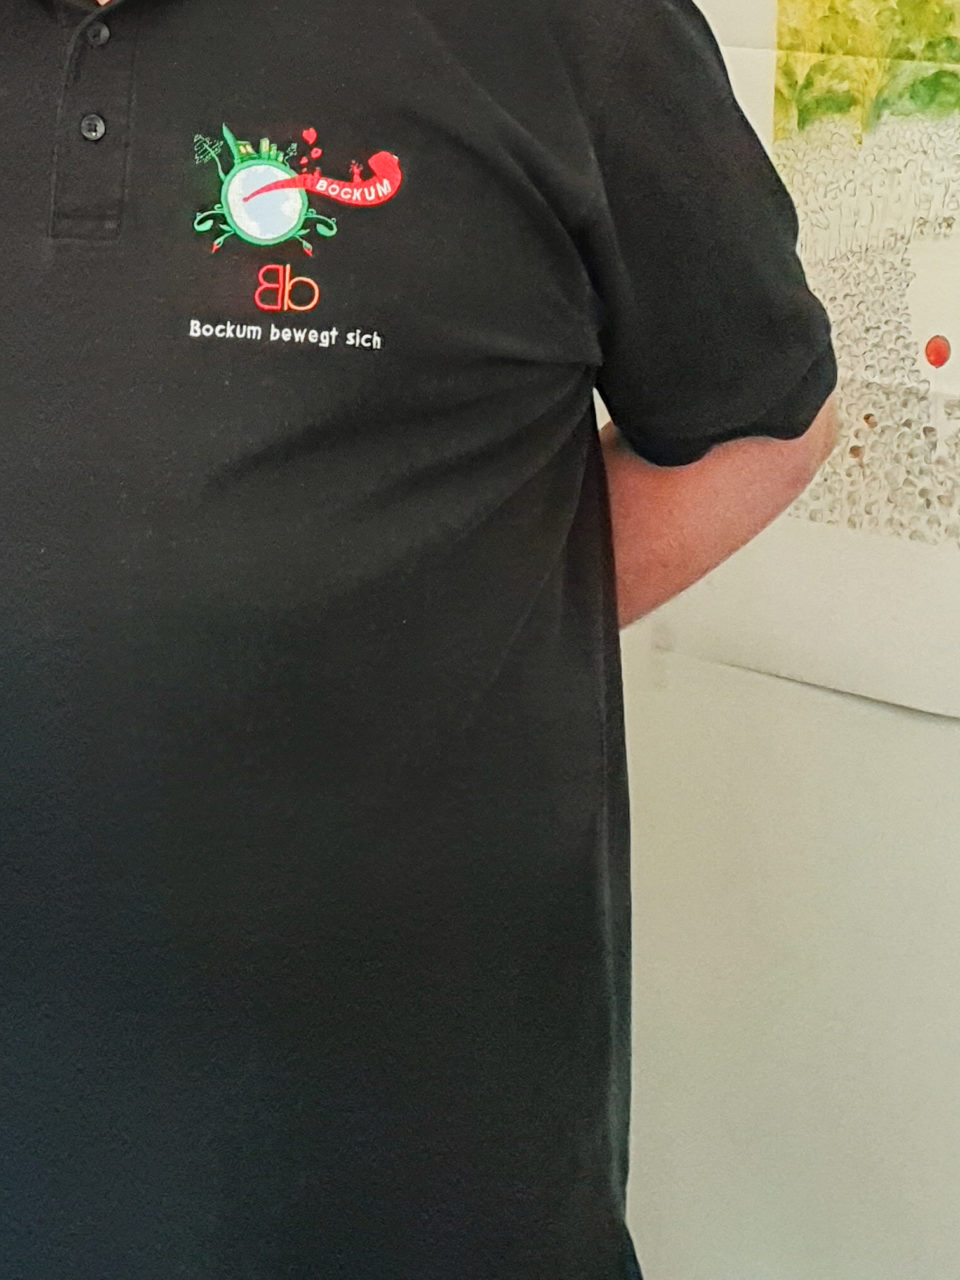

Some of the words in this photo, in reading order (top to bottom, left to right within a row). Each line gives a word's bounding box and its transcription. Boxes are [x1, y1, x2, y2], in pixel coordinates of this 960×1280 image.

[315, 178, 392, 201] BOCKUM
[189, 319, 262, 341] Bockum
[270, 324, 339, 348] bewegt
[345, 329, 382, 350] sich
